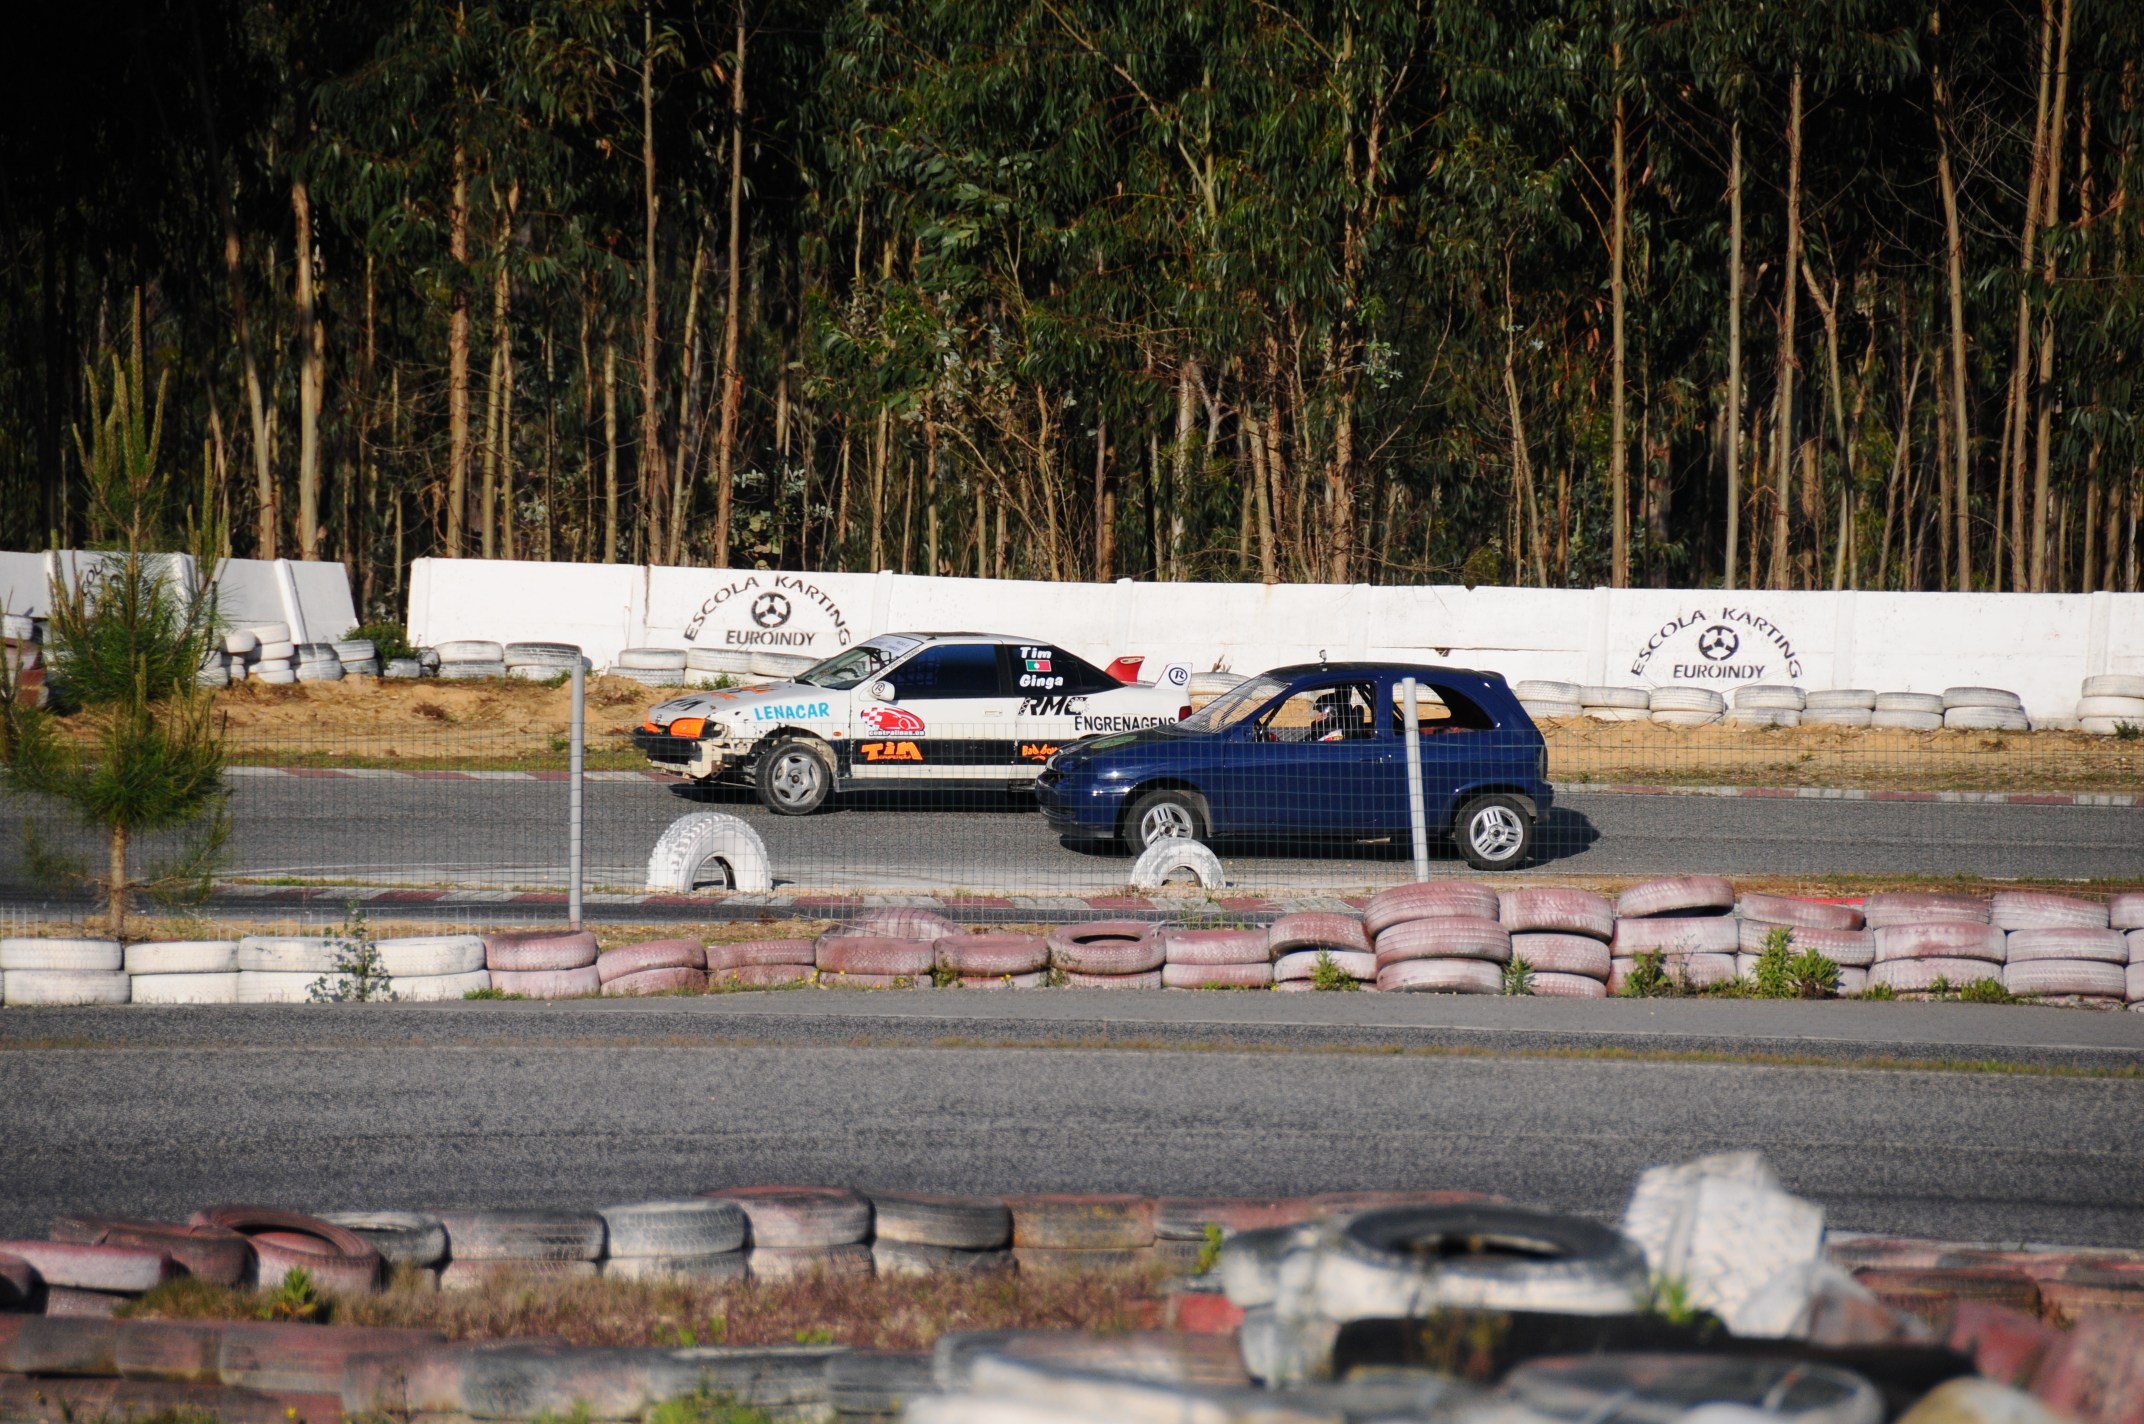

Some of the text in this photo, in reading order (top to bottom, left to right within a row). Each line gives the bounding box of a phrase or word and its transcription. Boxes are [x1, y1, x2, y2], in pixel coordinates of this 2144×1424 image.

[683, 575, 852, 646] ESCOLA KARTING
[725, 630, 816, 646] EUROINDY
[1630, 607, 1803, 679] ESCOLA KARTING
[1020, 646, 1052, 659] Tim
[1673, 664, 1766, 679] EUROINDY
[1019, 674, 1064, 690] Ginga
[754, 702, 830, 721] LENACAR
